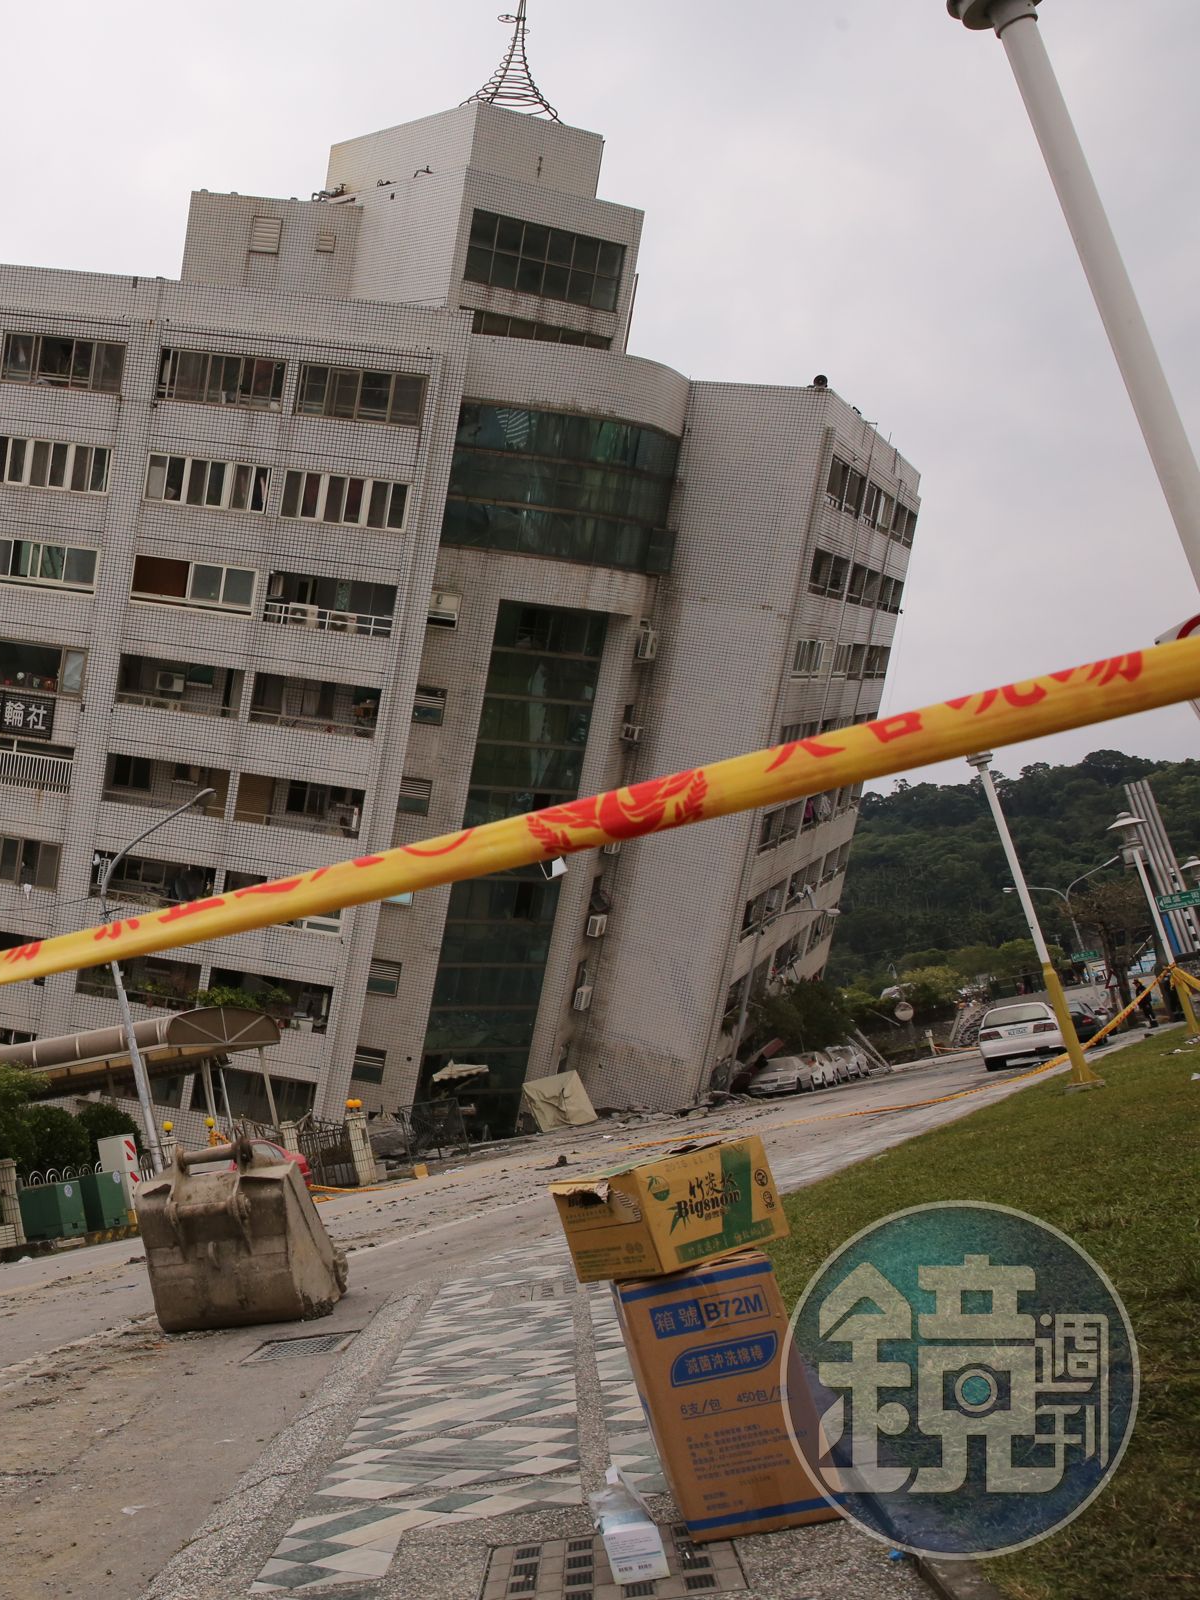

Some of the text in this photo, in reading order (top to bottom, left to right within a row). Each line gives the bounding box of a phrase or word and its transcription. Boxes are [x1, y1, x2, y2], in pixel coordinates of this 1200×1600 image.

[688, 1170, 738, 1201] 竹炭水
[675, 1190, 742, 1219] Bigsnow
[653, 1305, 702, 1333] 箱號
[703, 1293, 763, 1322] B72M
